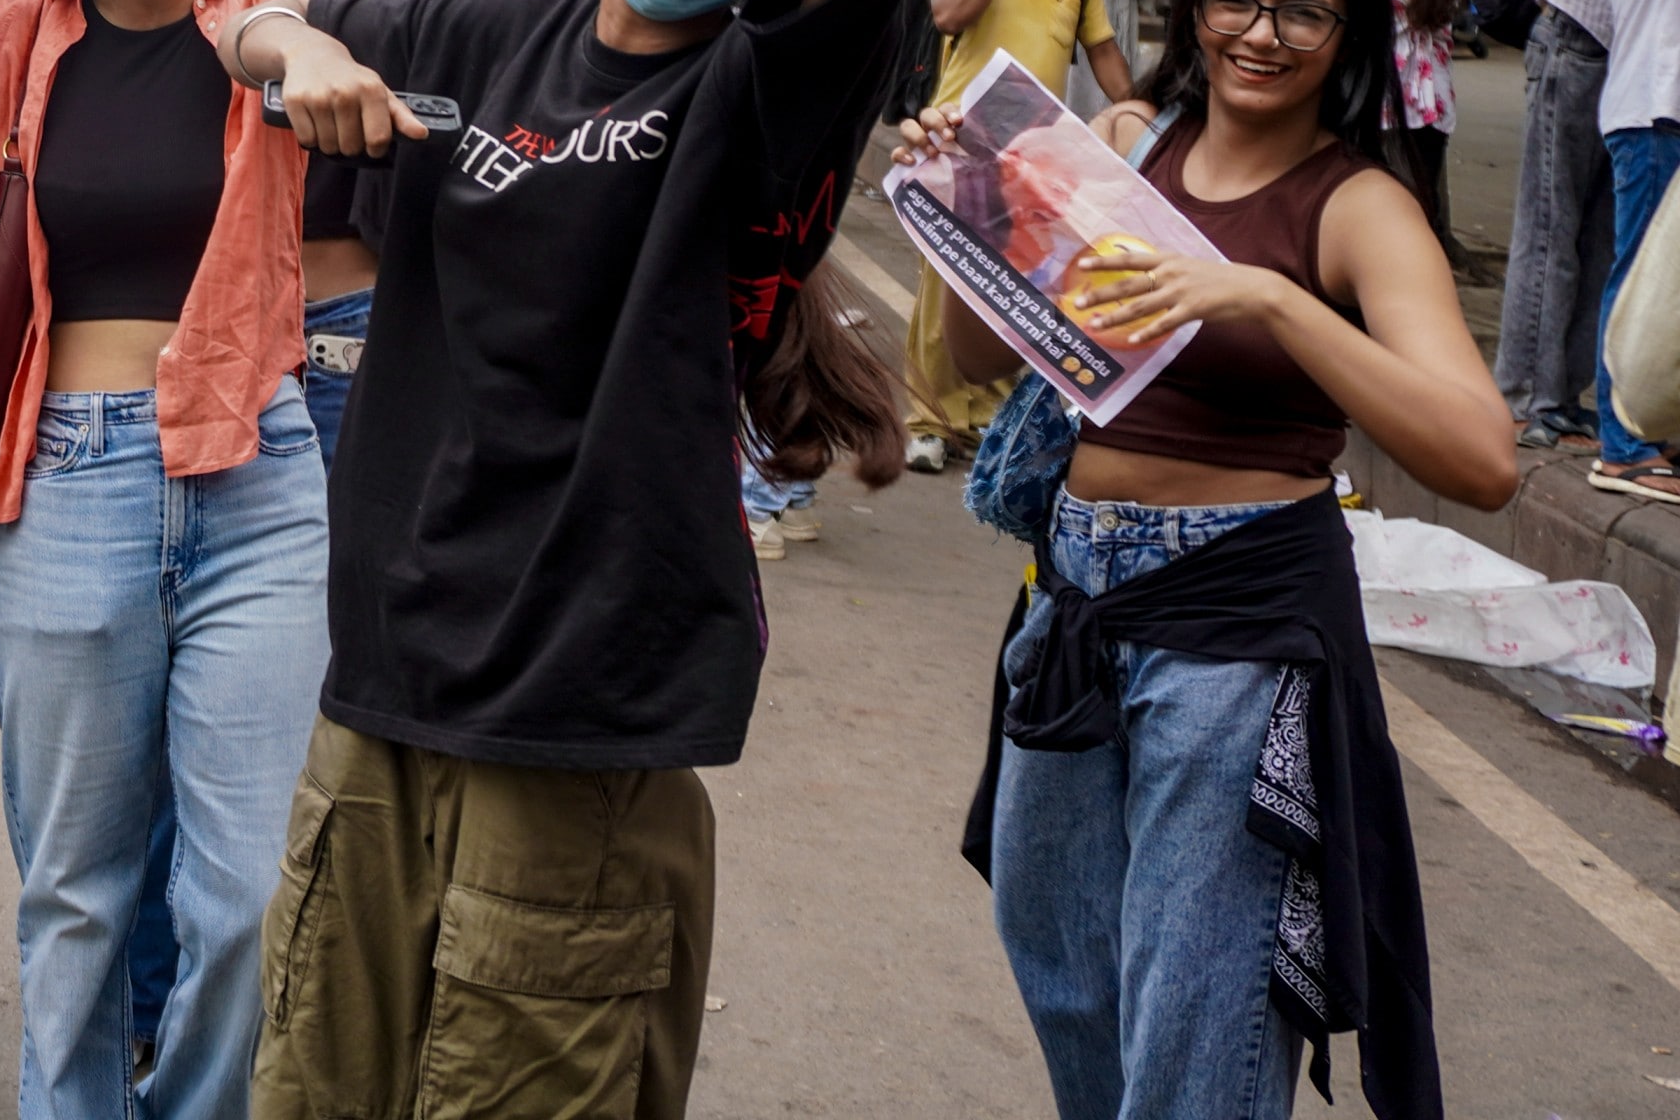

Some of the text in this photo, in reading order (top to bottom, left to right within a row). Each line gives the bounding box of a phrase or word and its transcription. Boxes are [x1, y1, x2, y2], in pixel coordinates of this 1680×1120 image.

[902, 201, 1067, 360] muslim pe baat kab karni hai
[907, 188, 1111, 378] agar ye protest ho gya ho to Hindu
